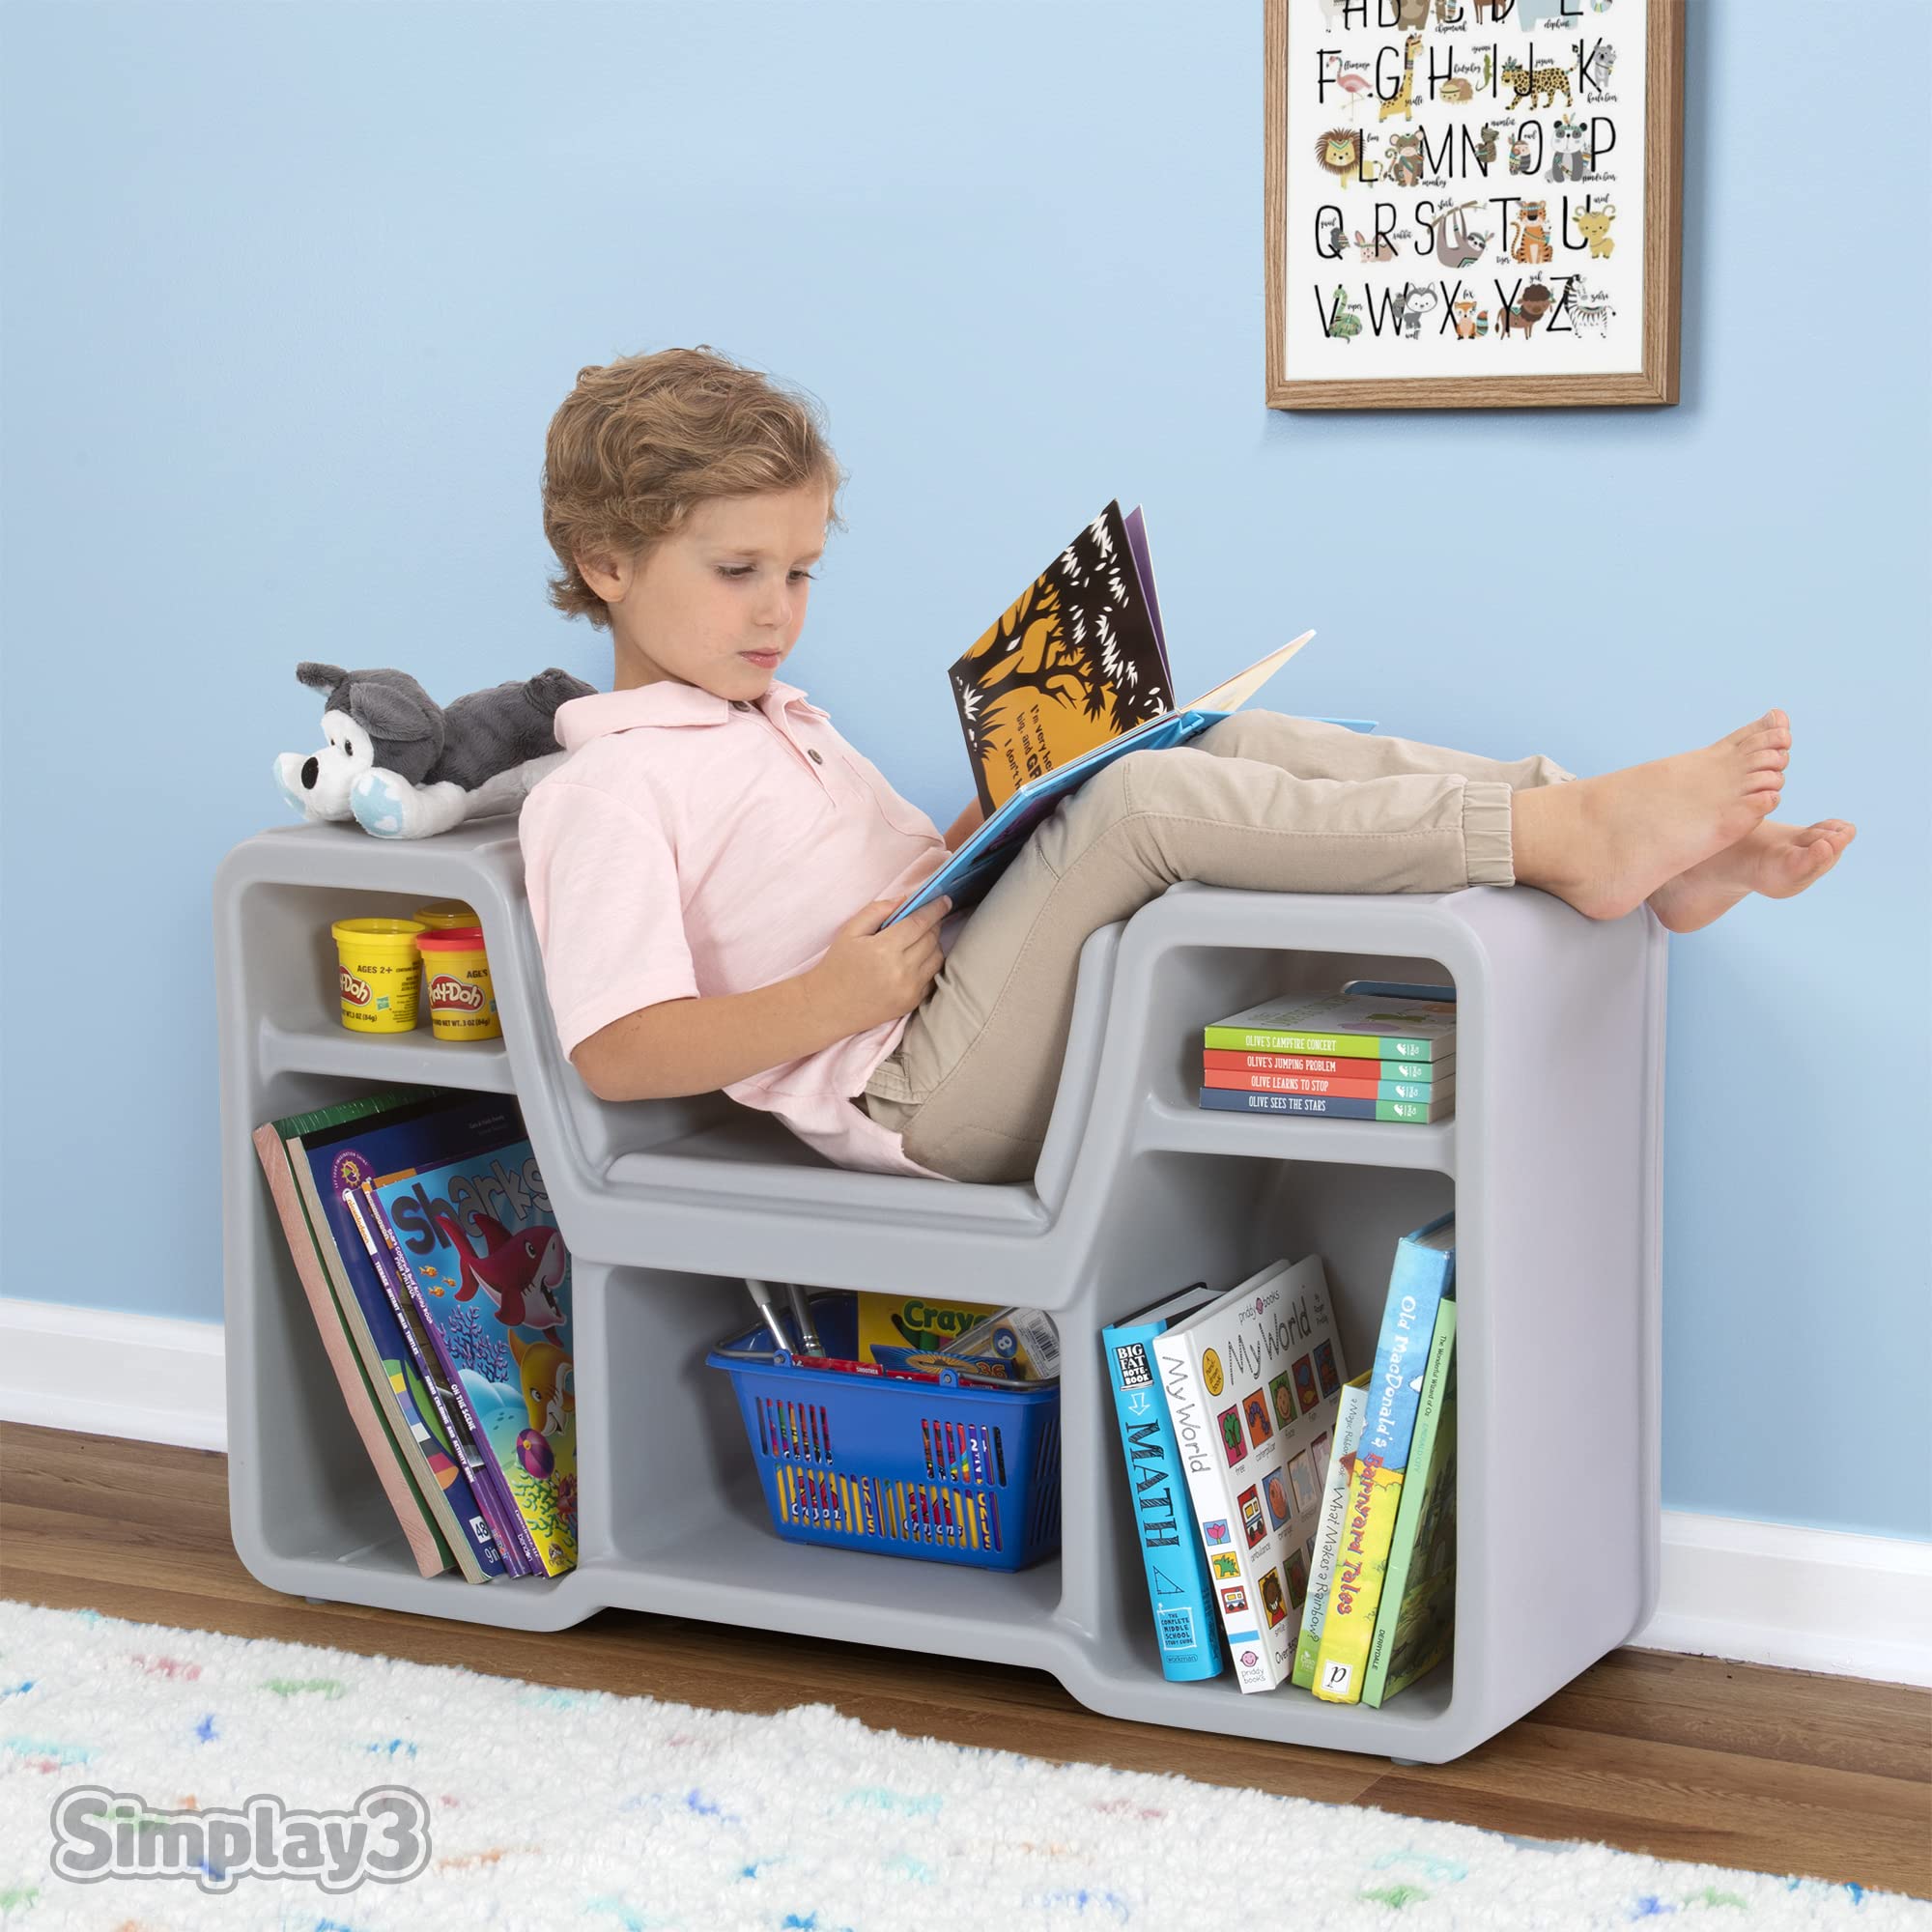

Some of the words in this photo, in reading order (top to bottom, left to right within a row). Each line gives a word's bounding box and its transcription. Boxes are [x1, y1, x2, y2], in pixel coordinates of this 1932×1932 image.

[1317, 49, 1342, 103] F
[1376, 46, 1400, 100] G
[1429, 44, 1453, 100] H
[1514, 42, 1533, 97] J
[1579, 37, 1603, 93] K
[1359, 128, 1378, 182] L
[1419, 124, 1453, 179] M
[1463, 123, 1488, 177] N
[1518, 120, 1543, 175] O
[1591, 117, 1616, 172] P
[1316, 205, 1343, 260] Q
[1376, 203, 1399, 257] R
[1414, 201, 1435, 255] S
[1489, 197, 1521, 252] T
[1563, 194, 1591, 249] U
[1314, 284, 1343, 338] V
[1365, 281, 1409, 336] W
[1439, 280, 1463, 335] X
[1494, 278, 1522, 332] Y
[1546, 276, 1575, 331] Z
[1022, 734, 1034, 755] and
[1036, 724, 1047, 753] very
[357, 965, 377, 974] AGES
[467, 969, 488, 979] AGES
[341, 973, 368, 1003] -Doh
[1245, 1036, 1270, 1047] OLIVE'S
[1272, 1037, 1305, 1049] CAMPFIRE
[1307, 1038, 1336, 1051] CONCERT
[1247, 1056, 1272, 1068] OLIVE'S
[1274, 1058, 1304, 1070] JUMPING
[1305, 1060, 1336, 1072] PROBLEM
[1251, 1075, 1271, 1088] OLIVE
[1272, 1077, 1298, 1090] LEARNS
[1300, 1079, 1310, 1091] TO
[1311, 1080, 1329, 1093] STOP
[1249, 1095, 1268, 1108] OLIVE
[1270, 1097, 1287, 1109] SEES
[1289, 1098, 1302, 1110] THE
[1304, 1099, 1326, 1112] STARS
[386, 1287, 401, 1313] MUTANT
[1398, 1295, 1416, 1330] Old
[1117, 1344, 1143, 1359] BIG
[1438, 1335, 1447, 1348] The
[1120, 1355, 1145, 1370] FAT
[1122, 1368, 1148, 1378] NOTE-
[1433, 1348, 1445, 1377] Wonderful
[1125, 1376, 1150, 1385] BOOK
[1429, 1377, 1439, 1398] Wizard
[451, 1383, 460, 1397] ON
[456, 1394, 468, 1411] THE
[462, 1409, 477, 1432] SCENE
[1163, 1355, 1188, 1402] My
[1177, 1404, 1211, 1473] World
[1346, 1406, 1357, 1430] Magic
[452, 1437, 468, 1465] ACTIVITY
[1125, 1419, 1179, 1548] MATH
[1327, 1486, 1346, 1524] What
[1348, 1452, 1384, 1555] Barnyard
[475, 1521, 489, 1539] 48
[1321, 1524, 1340, 1573] Makes
[1337, 1560, 1362, 1615] Tales
[1308, 1581, 1329, 1643] Rainbow?
[1373, 1629, 1385, 1670] DERRYDALE
[1241, 1667, 1264, 1679] priddy
[1243, 1675, 1266, 1685] books
